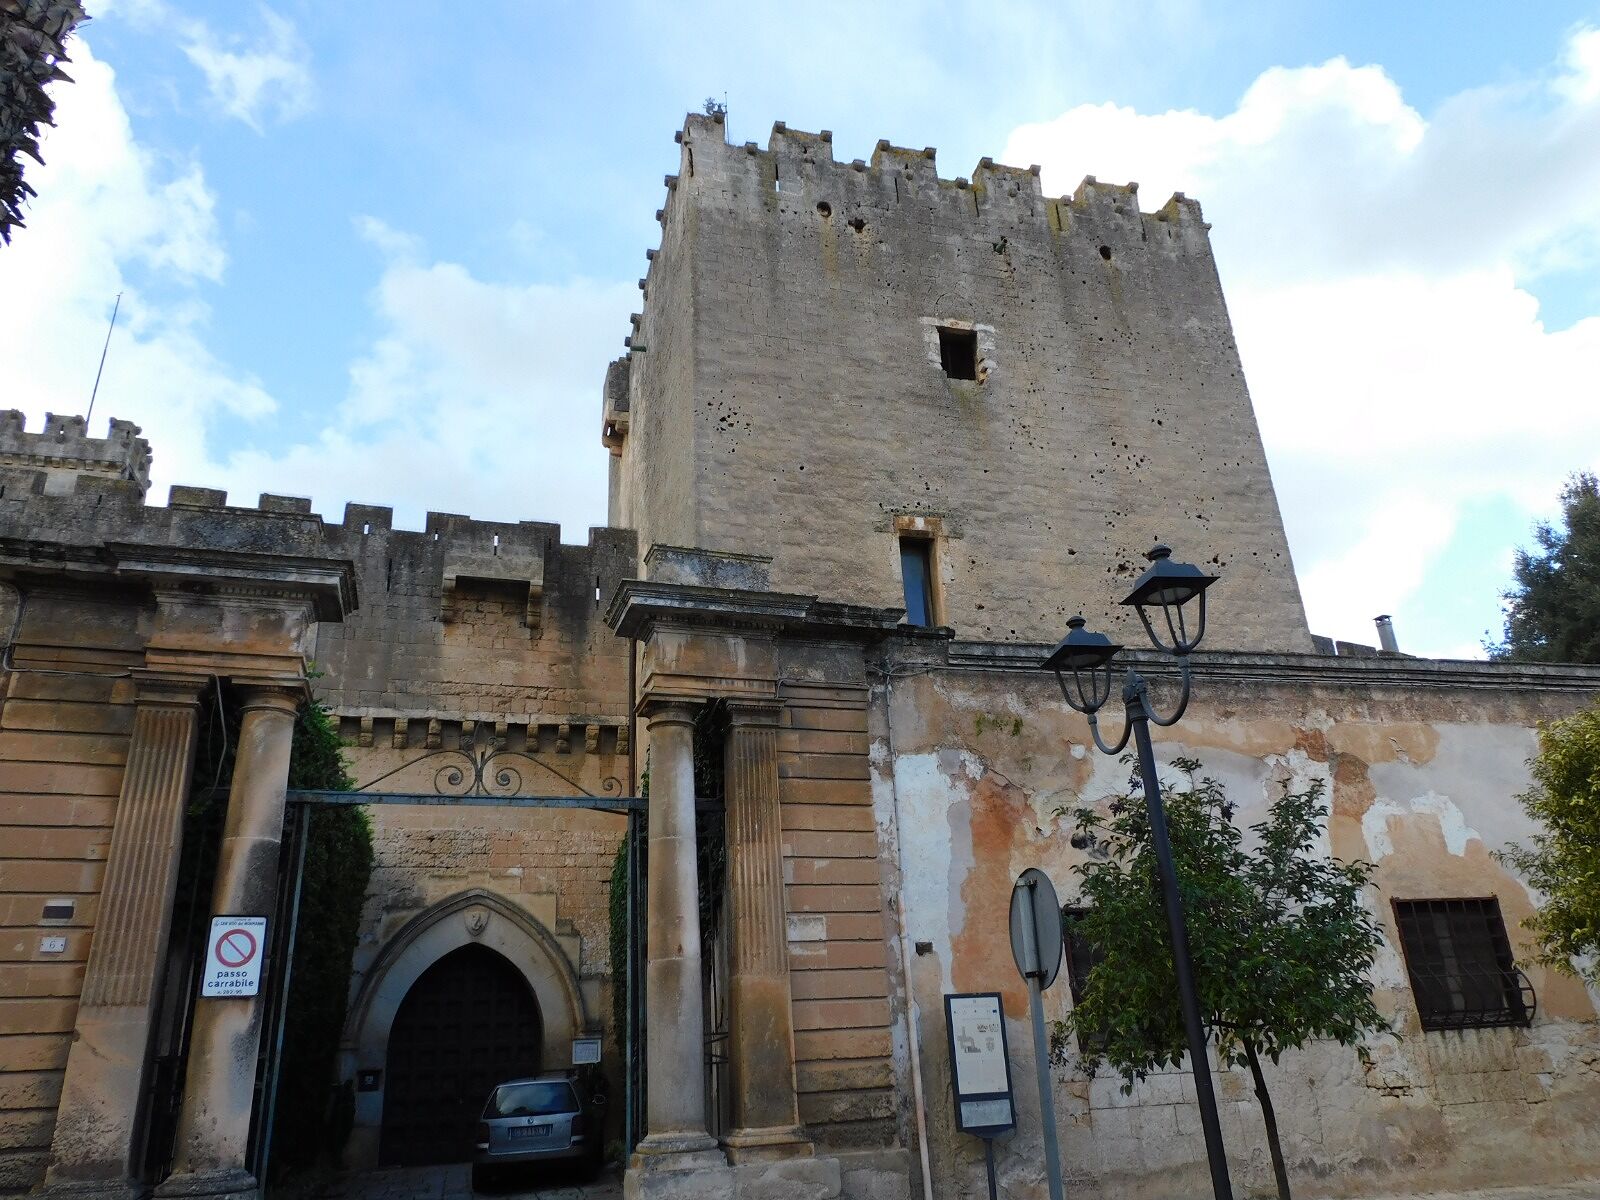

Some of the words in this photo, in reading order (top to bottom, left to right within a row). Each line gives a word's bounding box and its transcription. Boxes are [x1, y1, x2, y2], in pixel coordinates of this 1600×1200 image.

[50, 940, 55, 949] 6
[217, 971, 247, 979] passo
[208, 979, 254, 988] carrabile
